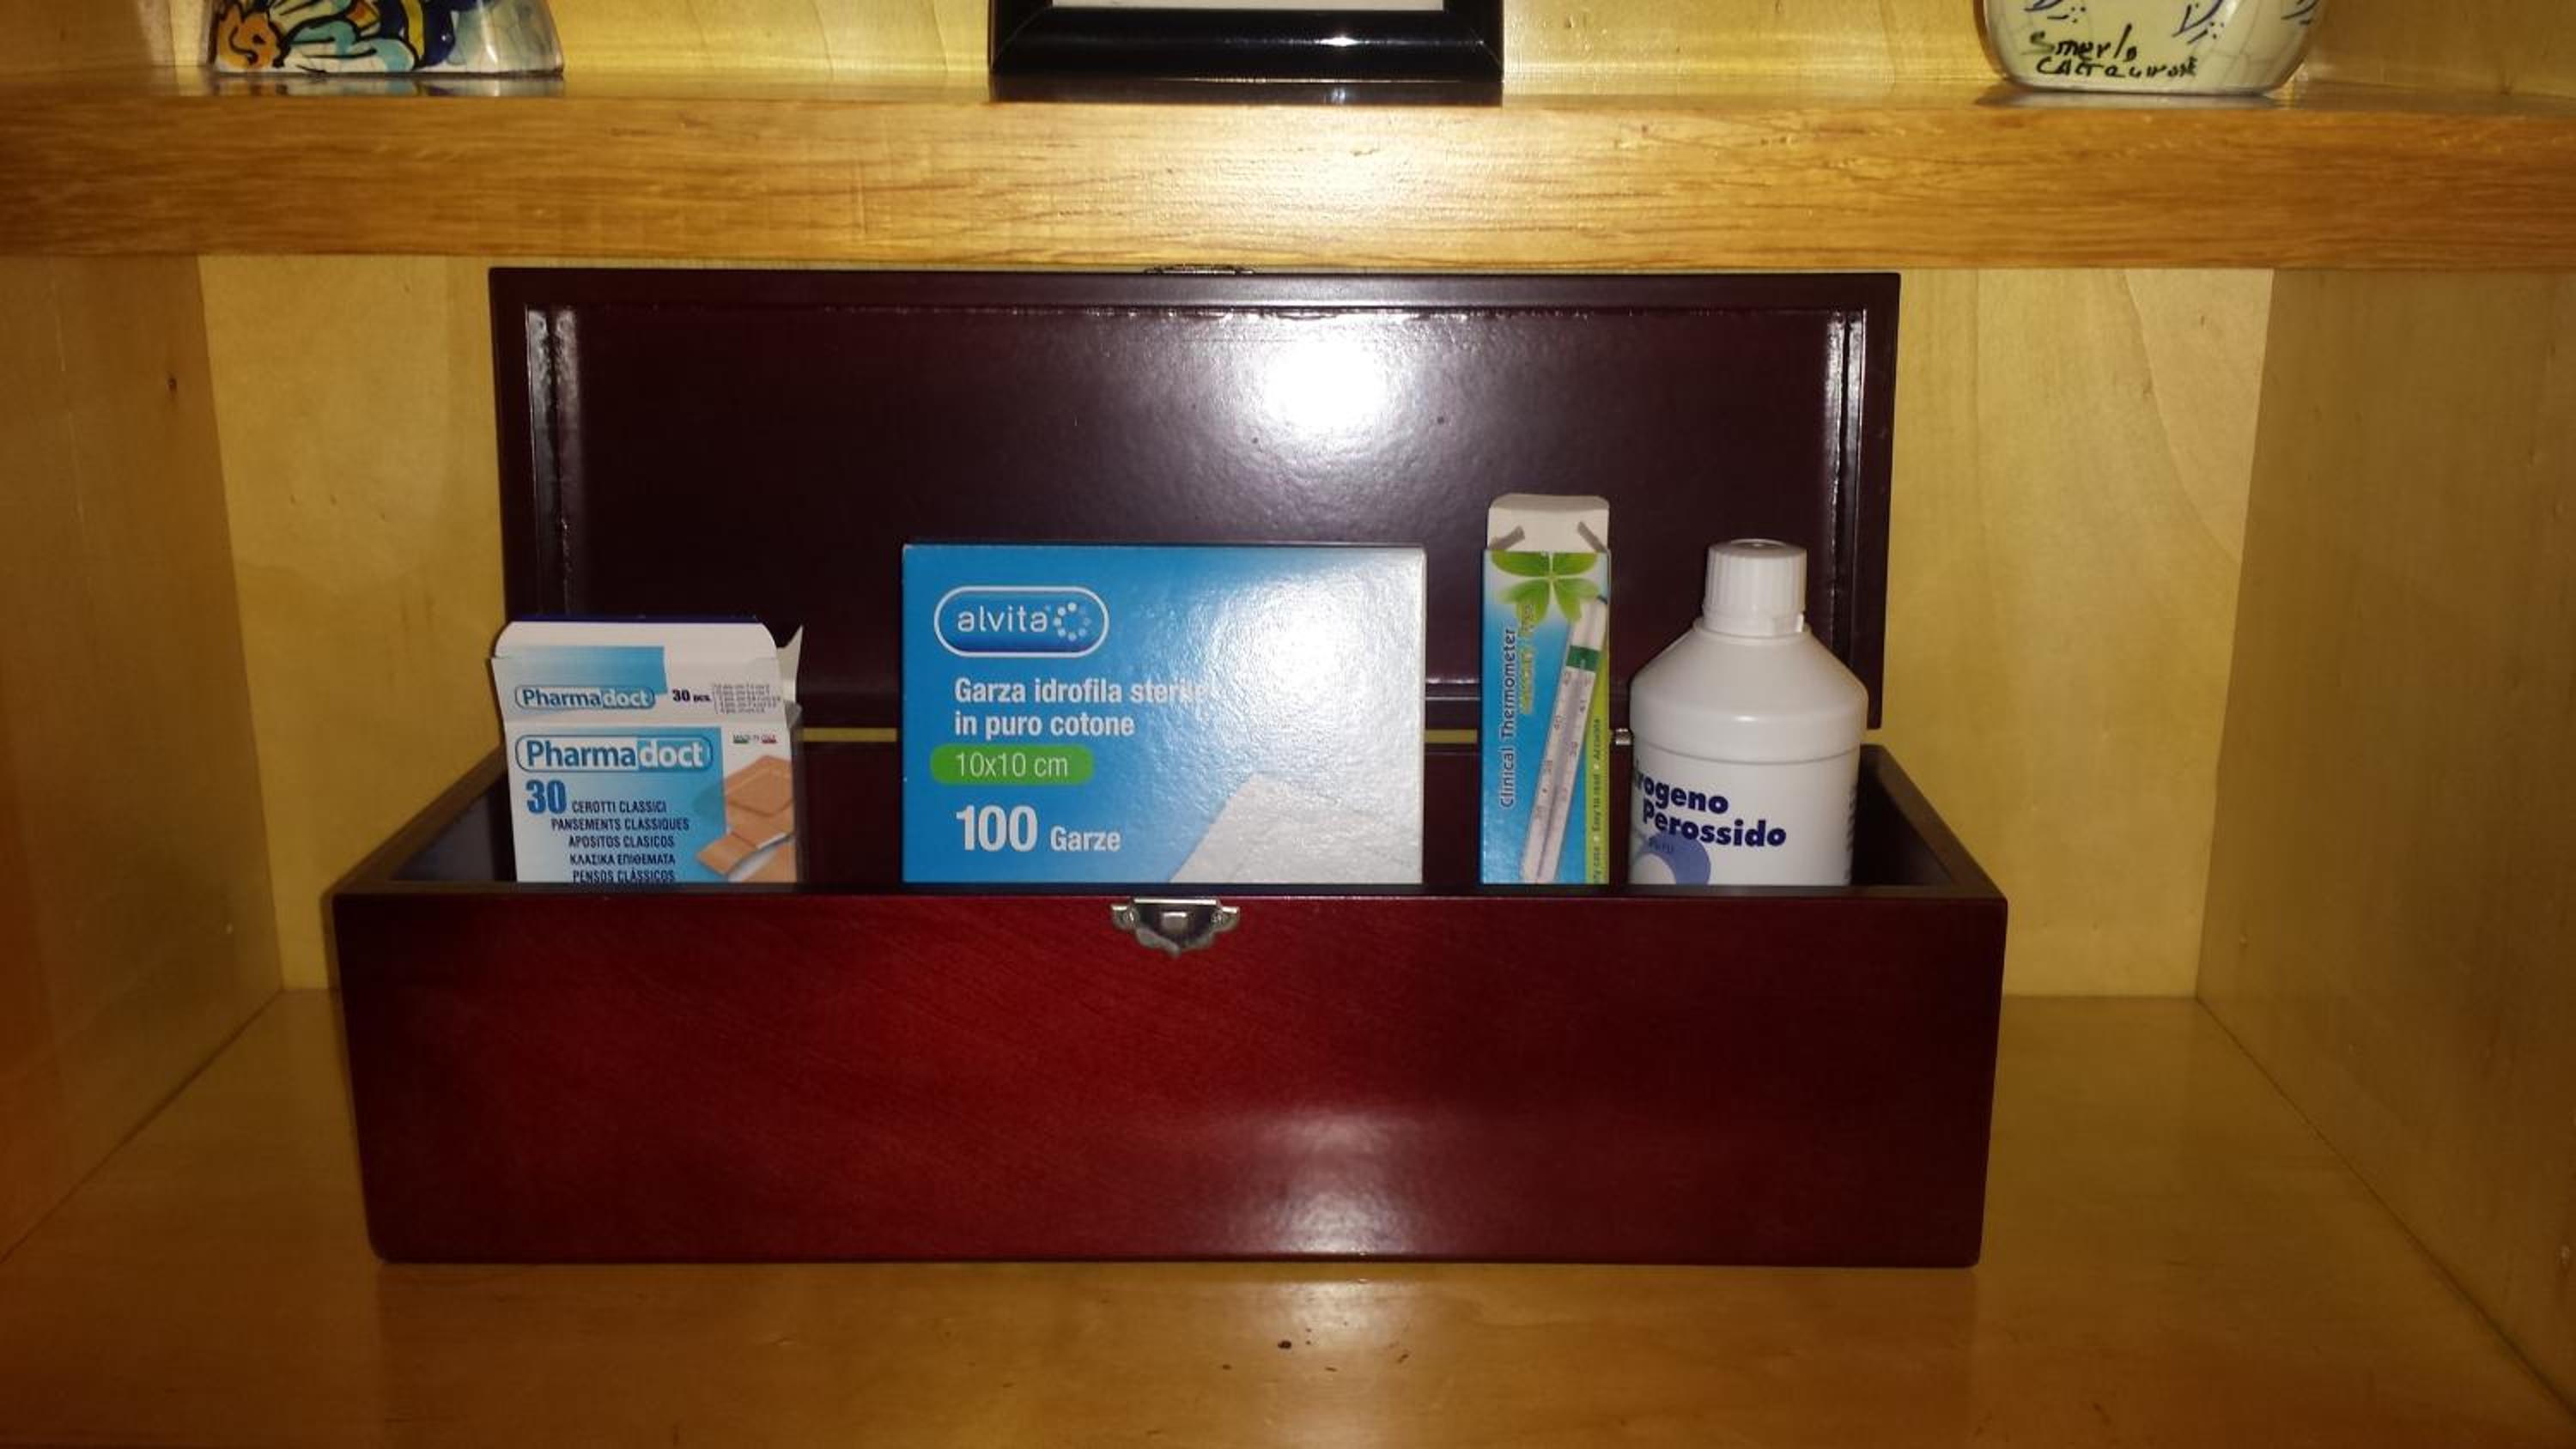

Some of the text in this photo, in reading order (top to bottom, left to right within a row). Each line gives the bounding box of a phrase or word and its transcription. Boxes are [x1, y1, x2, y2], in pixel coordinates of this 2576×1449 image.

[957, 606, 1048, 634] alvita
[522, 688, 650, 709] Pharmadoct
[672, 689, 690, 701] 30
[955, 676, 1026, 703] Garza
[1034, 676, 1122, 703] idrofila
[955, 711, 1136, 741] in puro cotone
[1500, 627, 1516, 808] Clinical Thermometer
[526, 740, 704, 768] Pharmadoct
[955, 752, 1068, 778] 10x10 cm
[526, 779, 666, 815] 30 CEROTTI CLASSICI
[551, 818, 690, 832] PANSEMENTS CLASSIQUES
[955, 805, 1121, 852] 100 Garze
[1643, 798, 1787, 846] Perossido
[568, 835, 675, 848] APOSITOS CLASICOS
